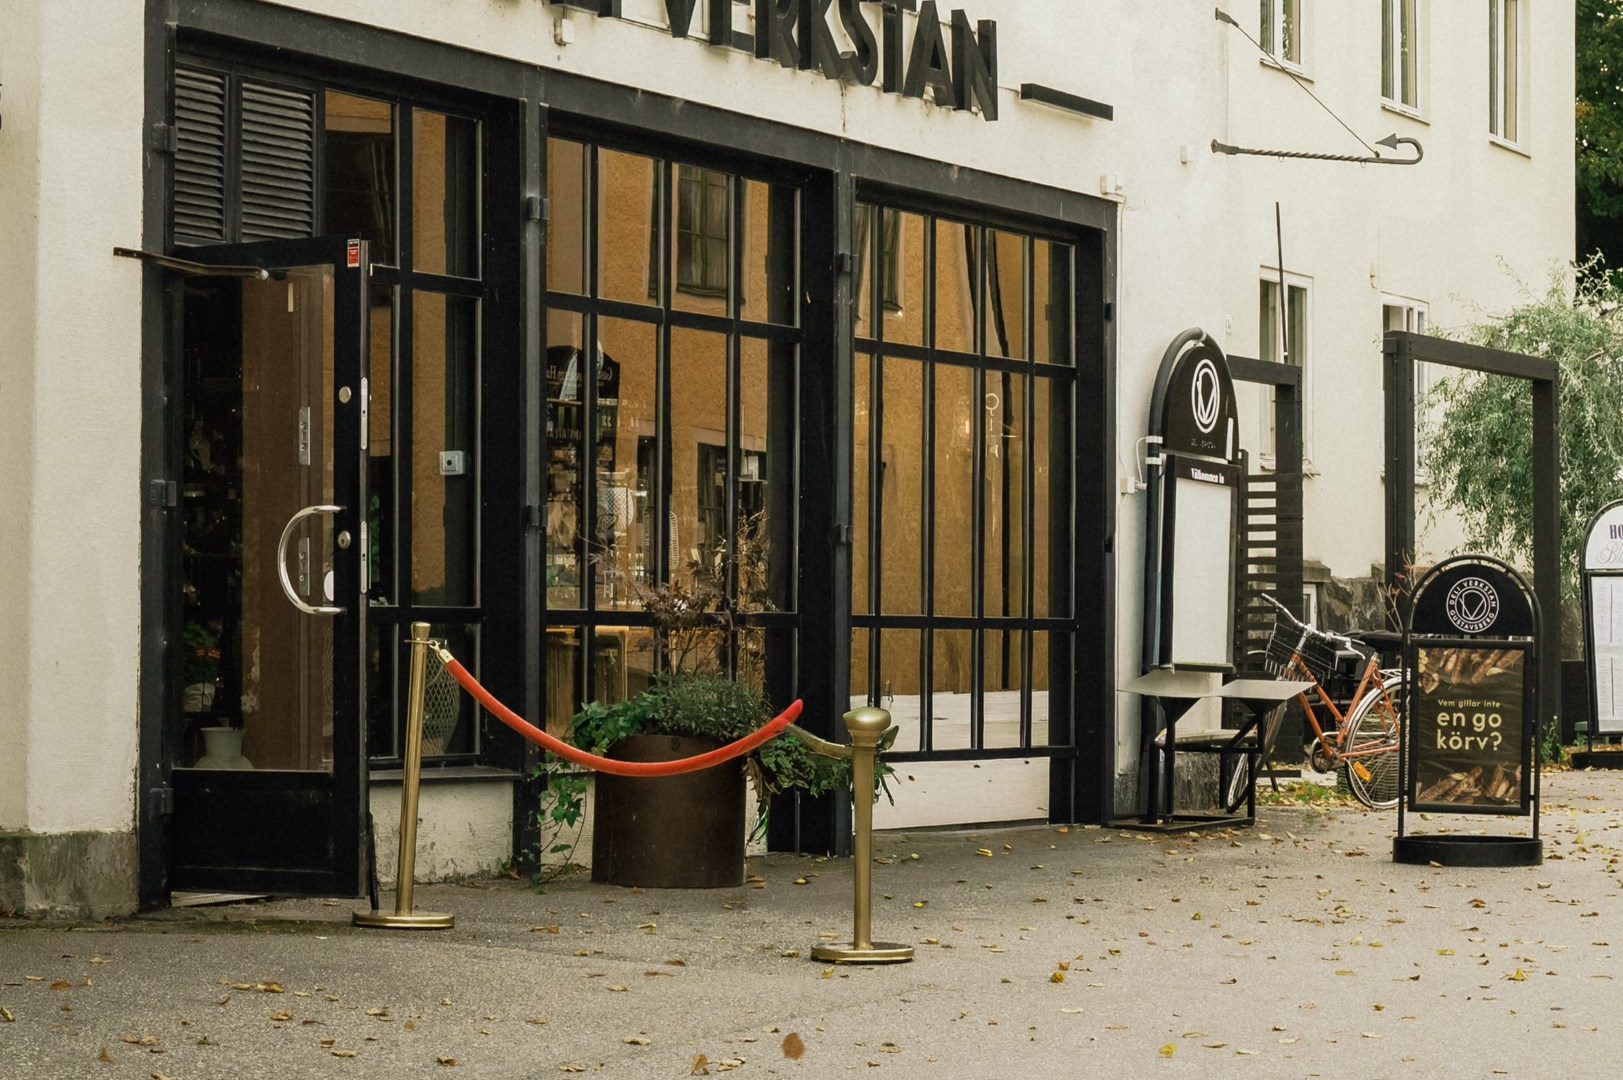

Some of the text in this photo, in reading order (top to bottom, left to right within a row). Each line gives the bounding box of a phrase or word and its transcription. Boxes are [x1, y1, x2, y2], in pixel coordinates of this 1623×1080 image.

[1449, 580, 1497, 608] DELI VERKSTAN
[1449, 609, 1495, 631] GUSTAVSBERG
[1437, 699, 1501, 709] Vem gillar inte
[1436, 711, 1502, 733] en go
[1436, 728, 1503, 752] körv?
